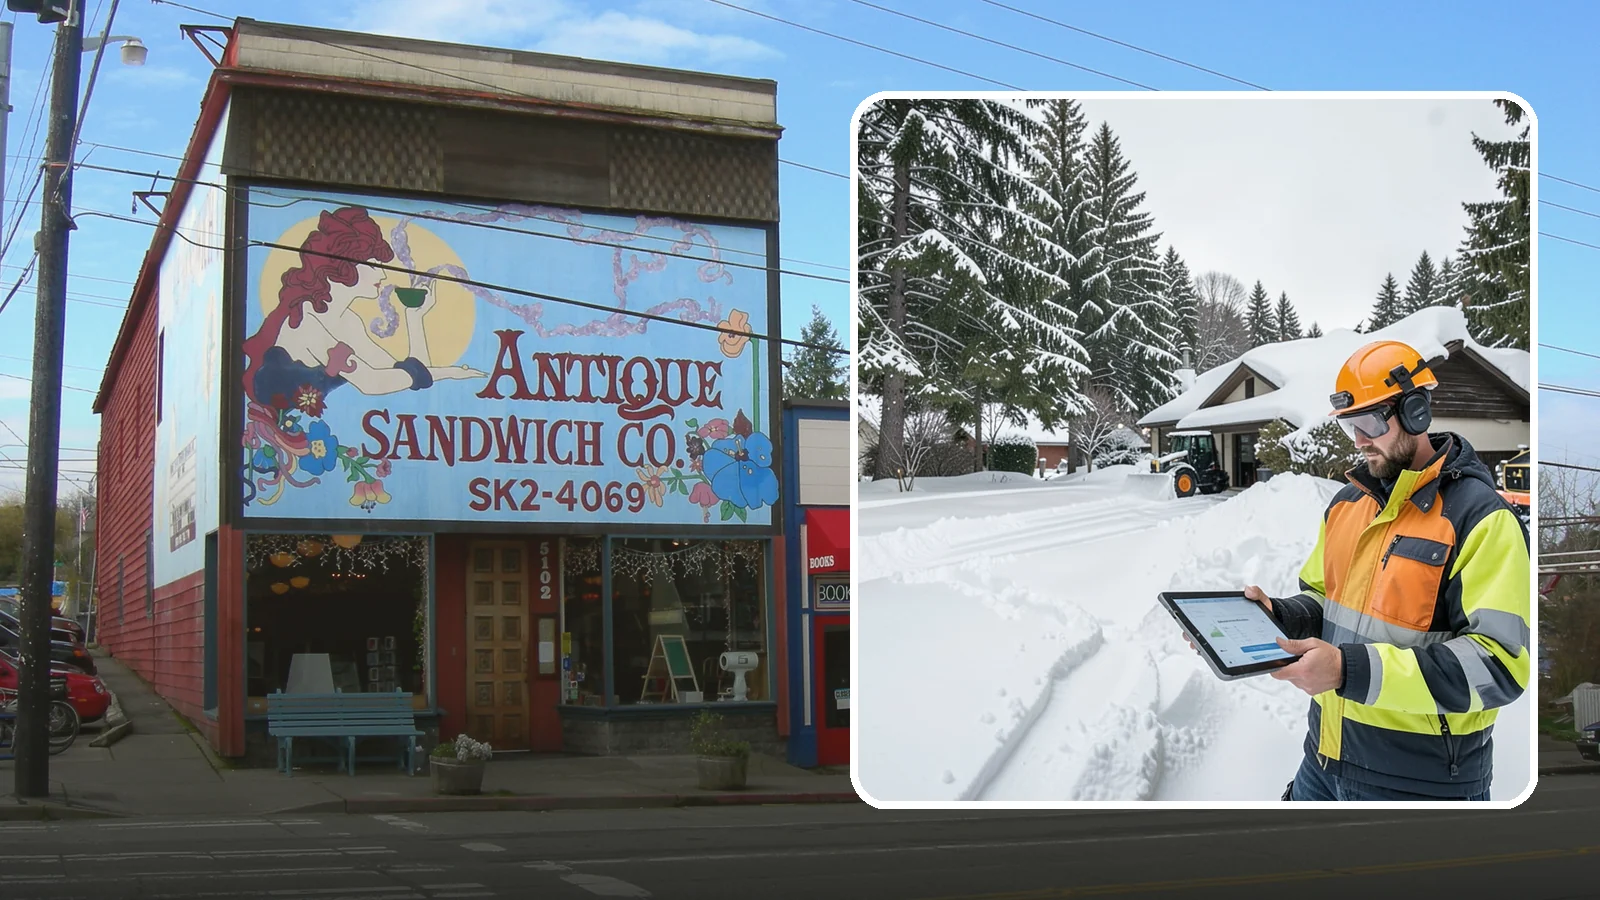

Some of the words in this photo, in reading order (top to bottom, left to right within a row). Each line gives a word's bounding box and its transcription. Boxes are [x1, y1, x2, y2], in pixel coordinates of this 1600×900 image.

[475, 328, 724, 421] ANTIQUE
[360, 408, 605, 467] SANDWICH
[617, 422, 685, 469] CO.
[468, 477, 646, 514] SK2-4069
[539, 542, 552, 600] 5102
[809, 555, 835, 569] BOOKS
